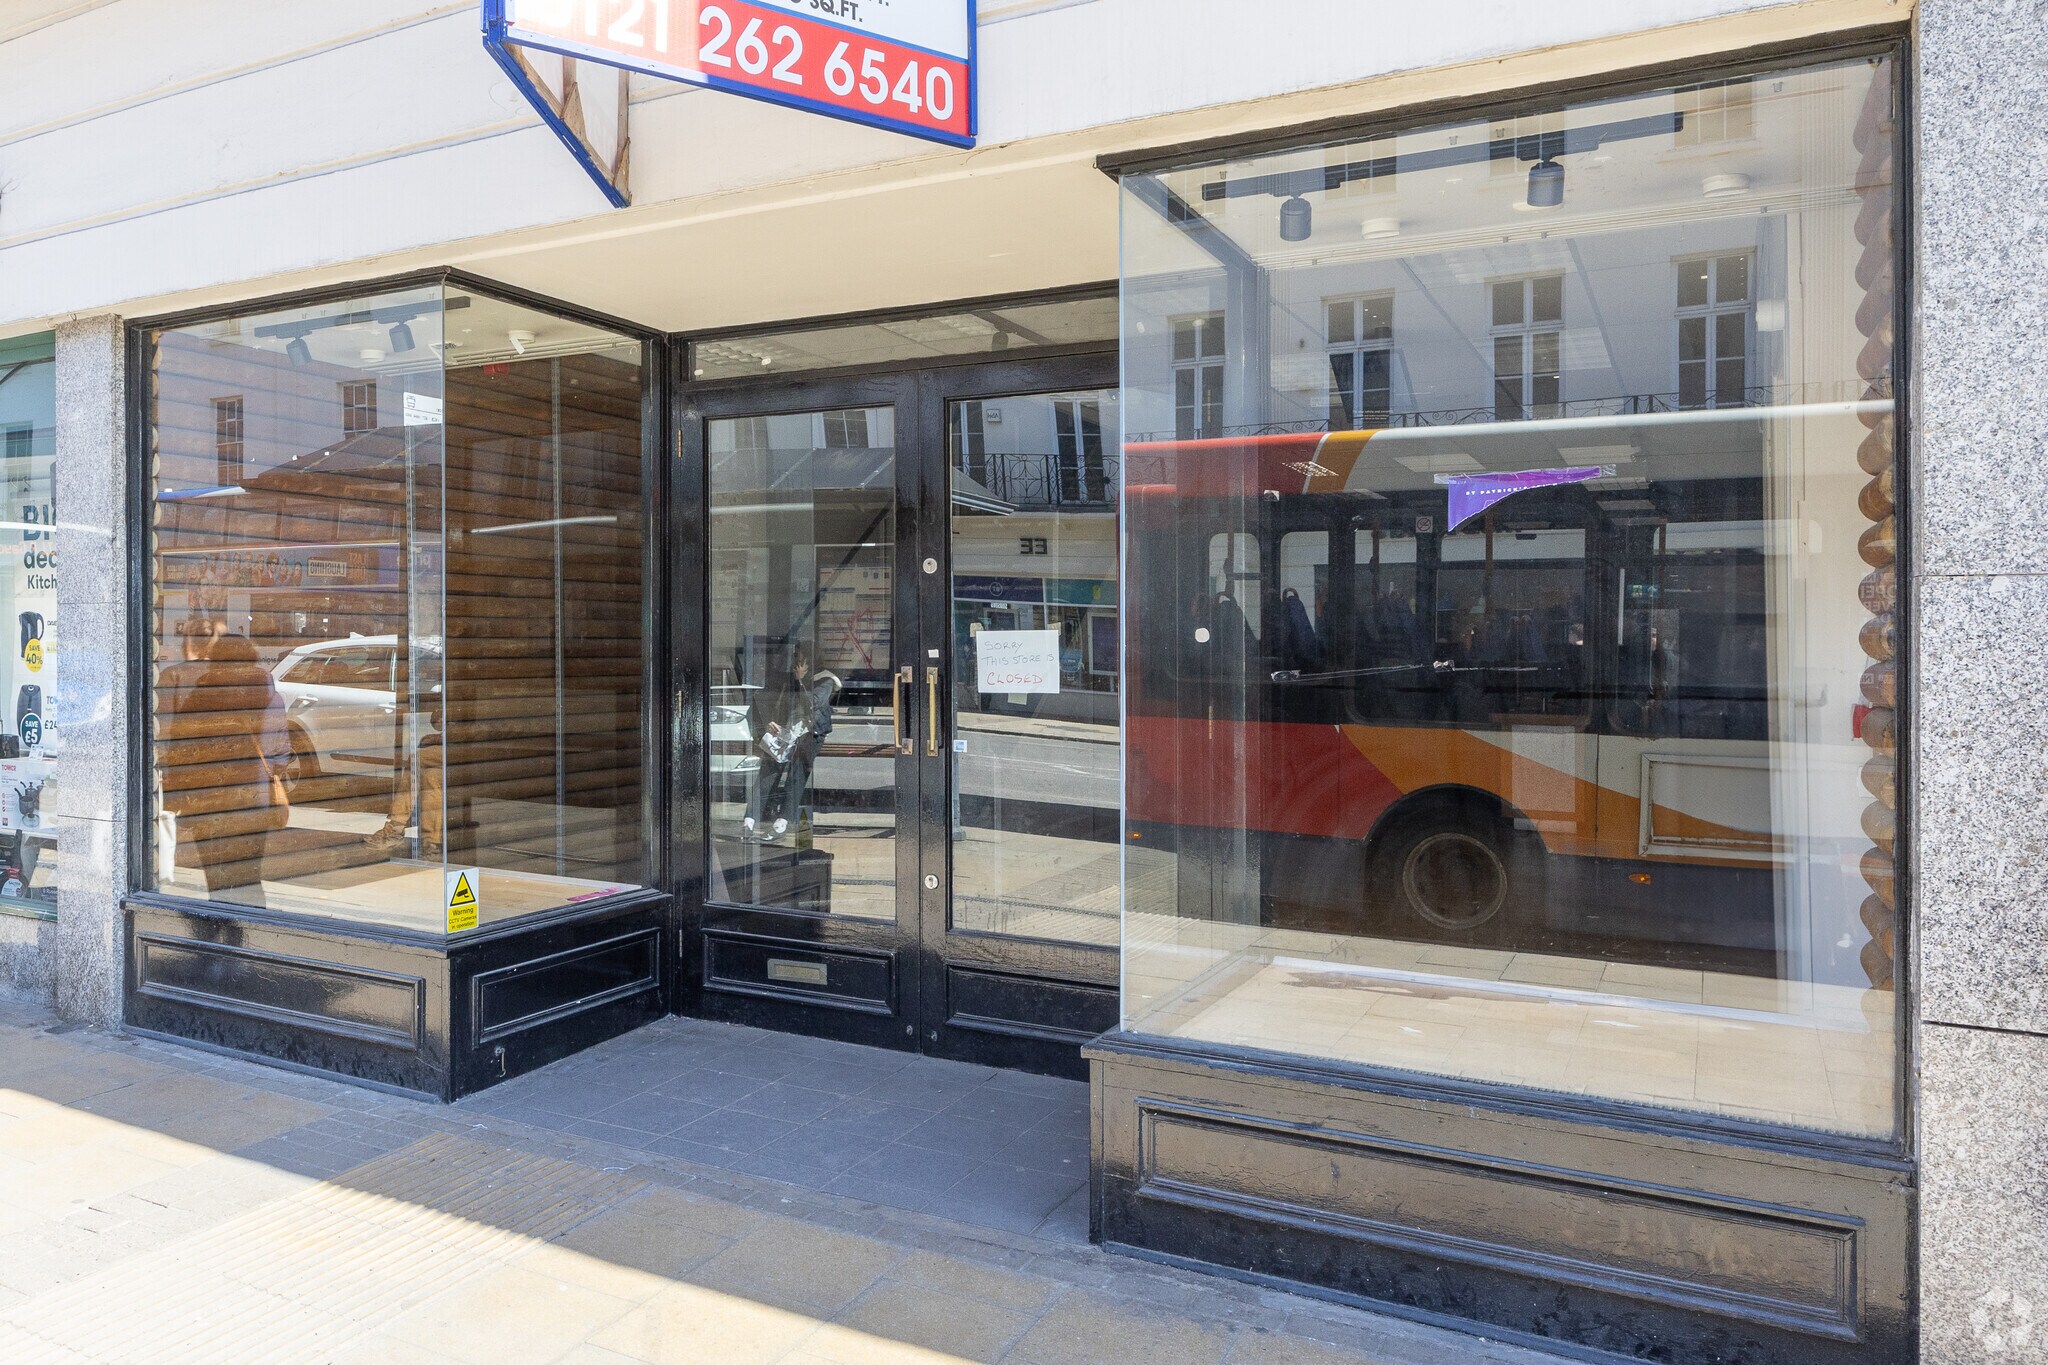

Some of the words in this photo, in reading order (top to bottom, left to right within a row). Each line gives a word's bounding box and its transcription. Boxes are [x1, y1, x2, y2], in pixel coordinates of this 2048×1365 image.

[699, 5, 803, 85] 262
[824, 42, 954, 120] 6540
[28, 644, 41, 652] SAVE
[984, 640, 1023, 653] SORRY
[981, 656, 1009, 666] THIS
[1013, 654, 1041, 665] STORE
[1046, 653, 1055, 662] IS
[987, 672, 1043, 685] CLOSED
[24, 720, 39, 728] SAVE
[24, 728, 38, 744] £5
[452, 907, 474, 916] Warning
